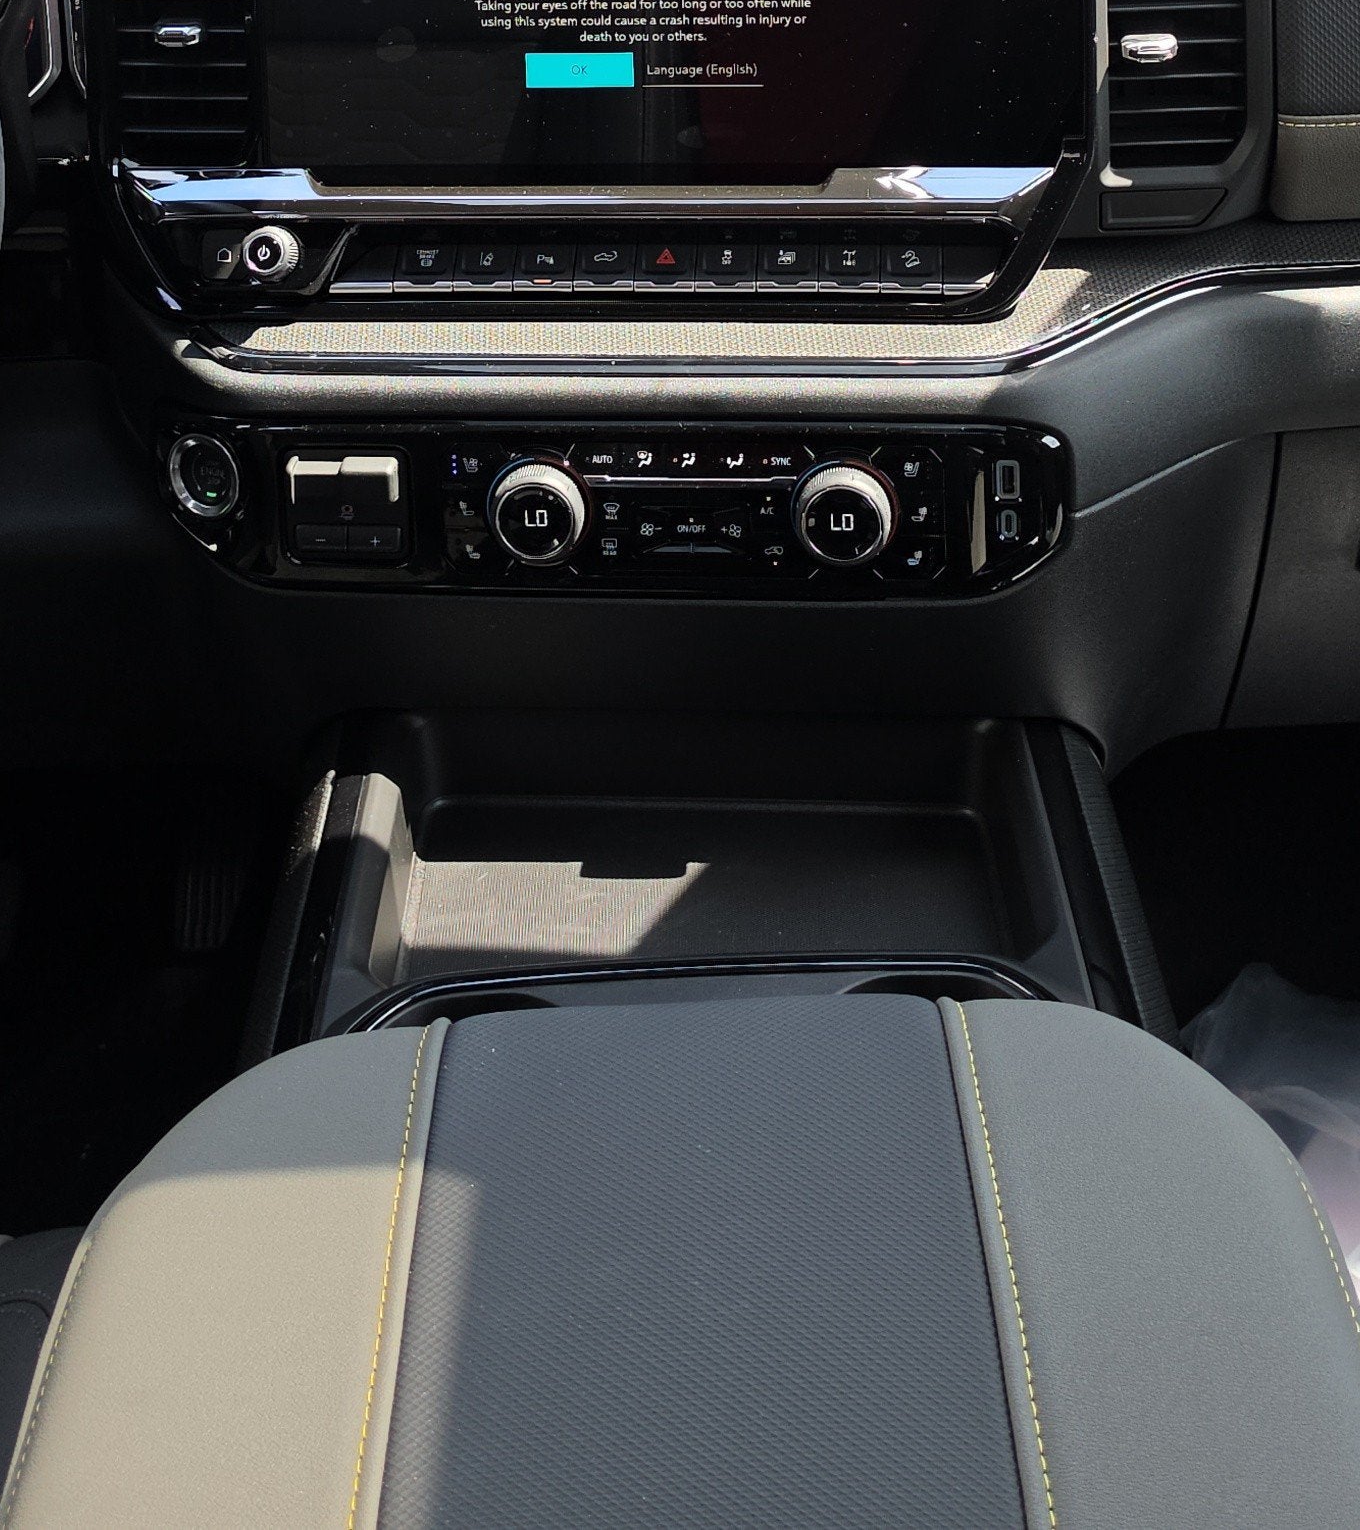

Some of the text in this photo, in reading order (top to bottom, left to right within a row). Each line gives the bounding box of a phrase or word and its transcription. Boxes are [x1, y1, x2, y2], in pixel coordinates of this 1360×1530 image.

[474, 0, 511, 13] Taking
[514, 2, 539, 12] your
[542, 2, 568, 12] eyes
[659, 0, 678, 9] too
[709, 0, 721, 8] or
[481, 14, 807, 30] using this system could cause a crash resulting in injury or
[580, 30, 707, 44] death to you or others.
[571, 64, 588, 76] OK
[646, 63, 758, 78] Language (English)
[592, 455, 613, 464] AUTO
[770, 457, 792, 466] SYNC
[760, 507, 774, 515] A/C
[677, 524, 706, 533] ON/OFF
